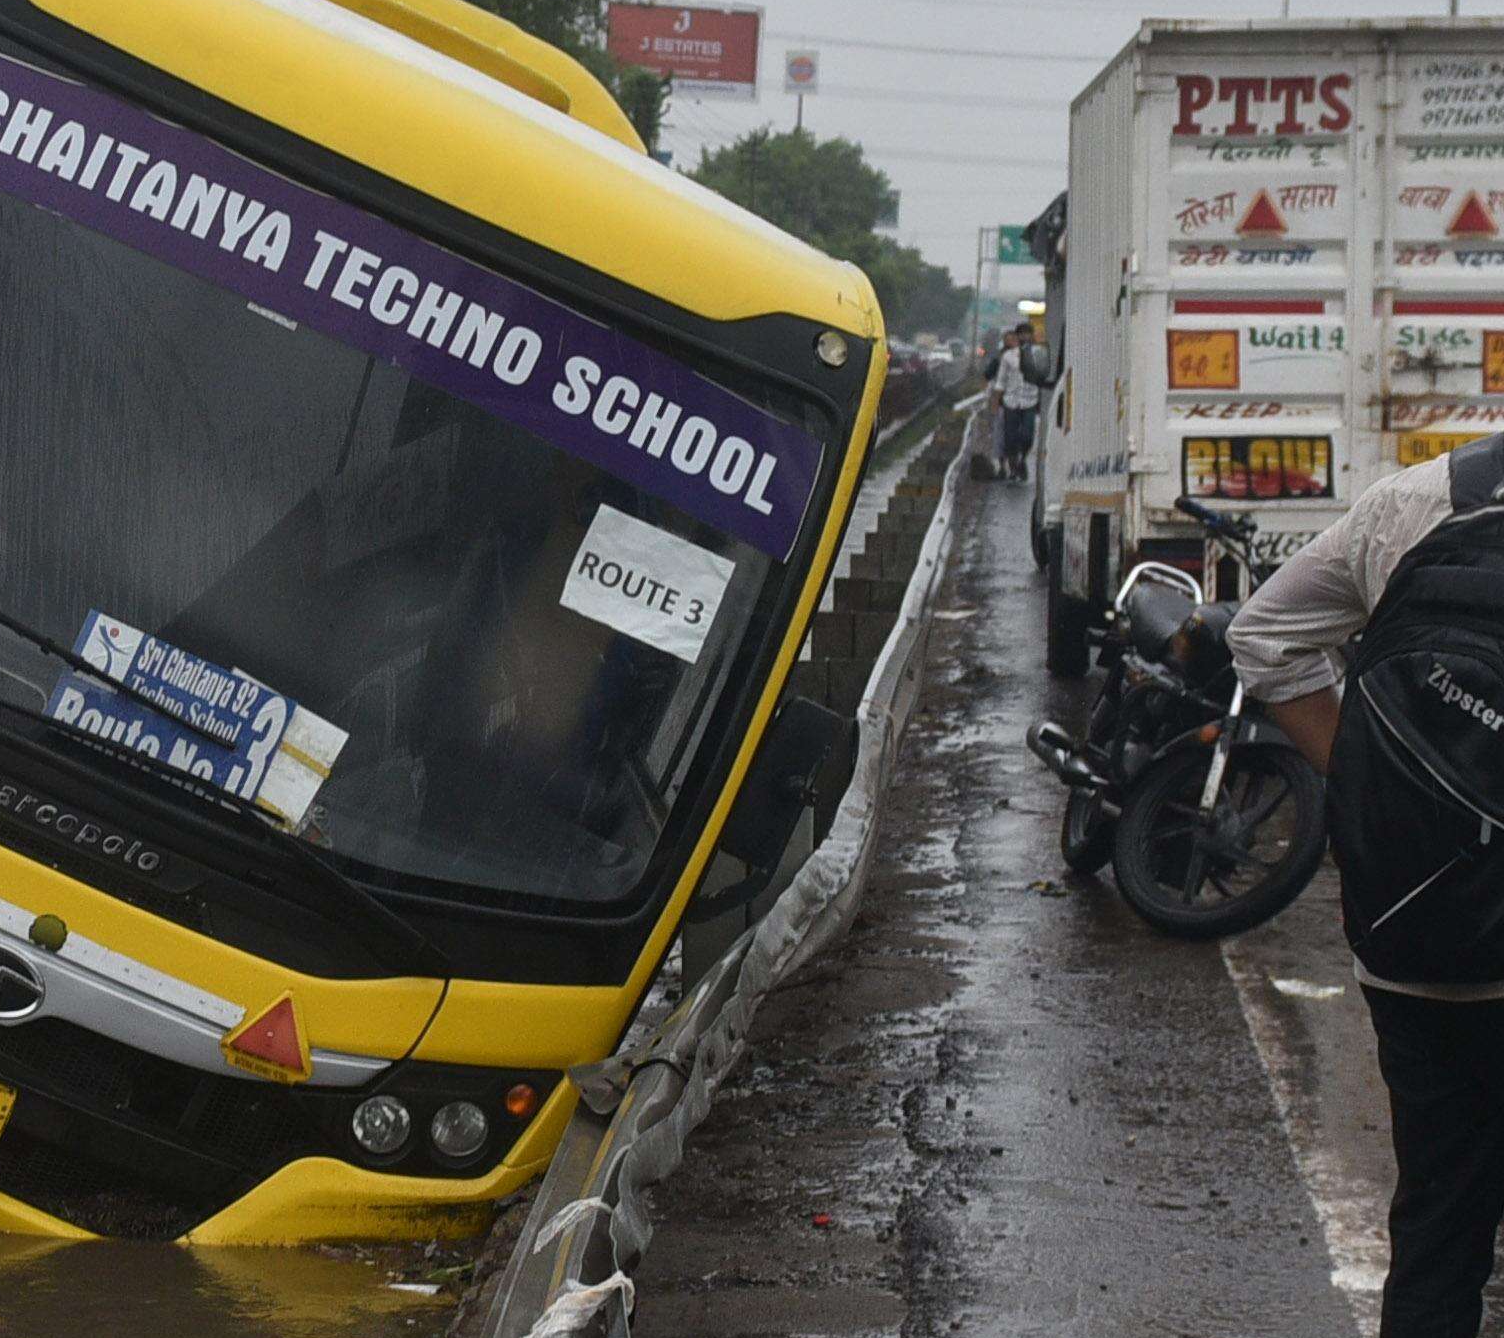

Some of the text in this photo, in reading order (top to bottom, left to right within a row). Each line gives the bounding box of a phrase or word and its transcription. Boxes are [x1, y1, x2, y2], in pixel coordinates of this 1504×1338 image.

[303, 229, 544, 387] TECHNO
[551, 356, 779, 516] SCHOOL
[577, 550, 706, 626] ROUTE 3
[132, 674, 243, 744] Techno School
[137, 636, 259, 719] Sri Chaitanya 92
